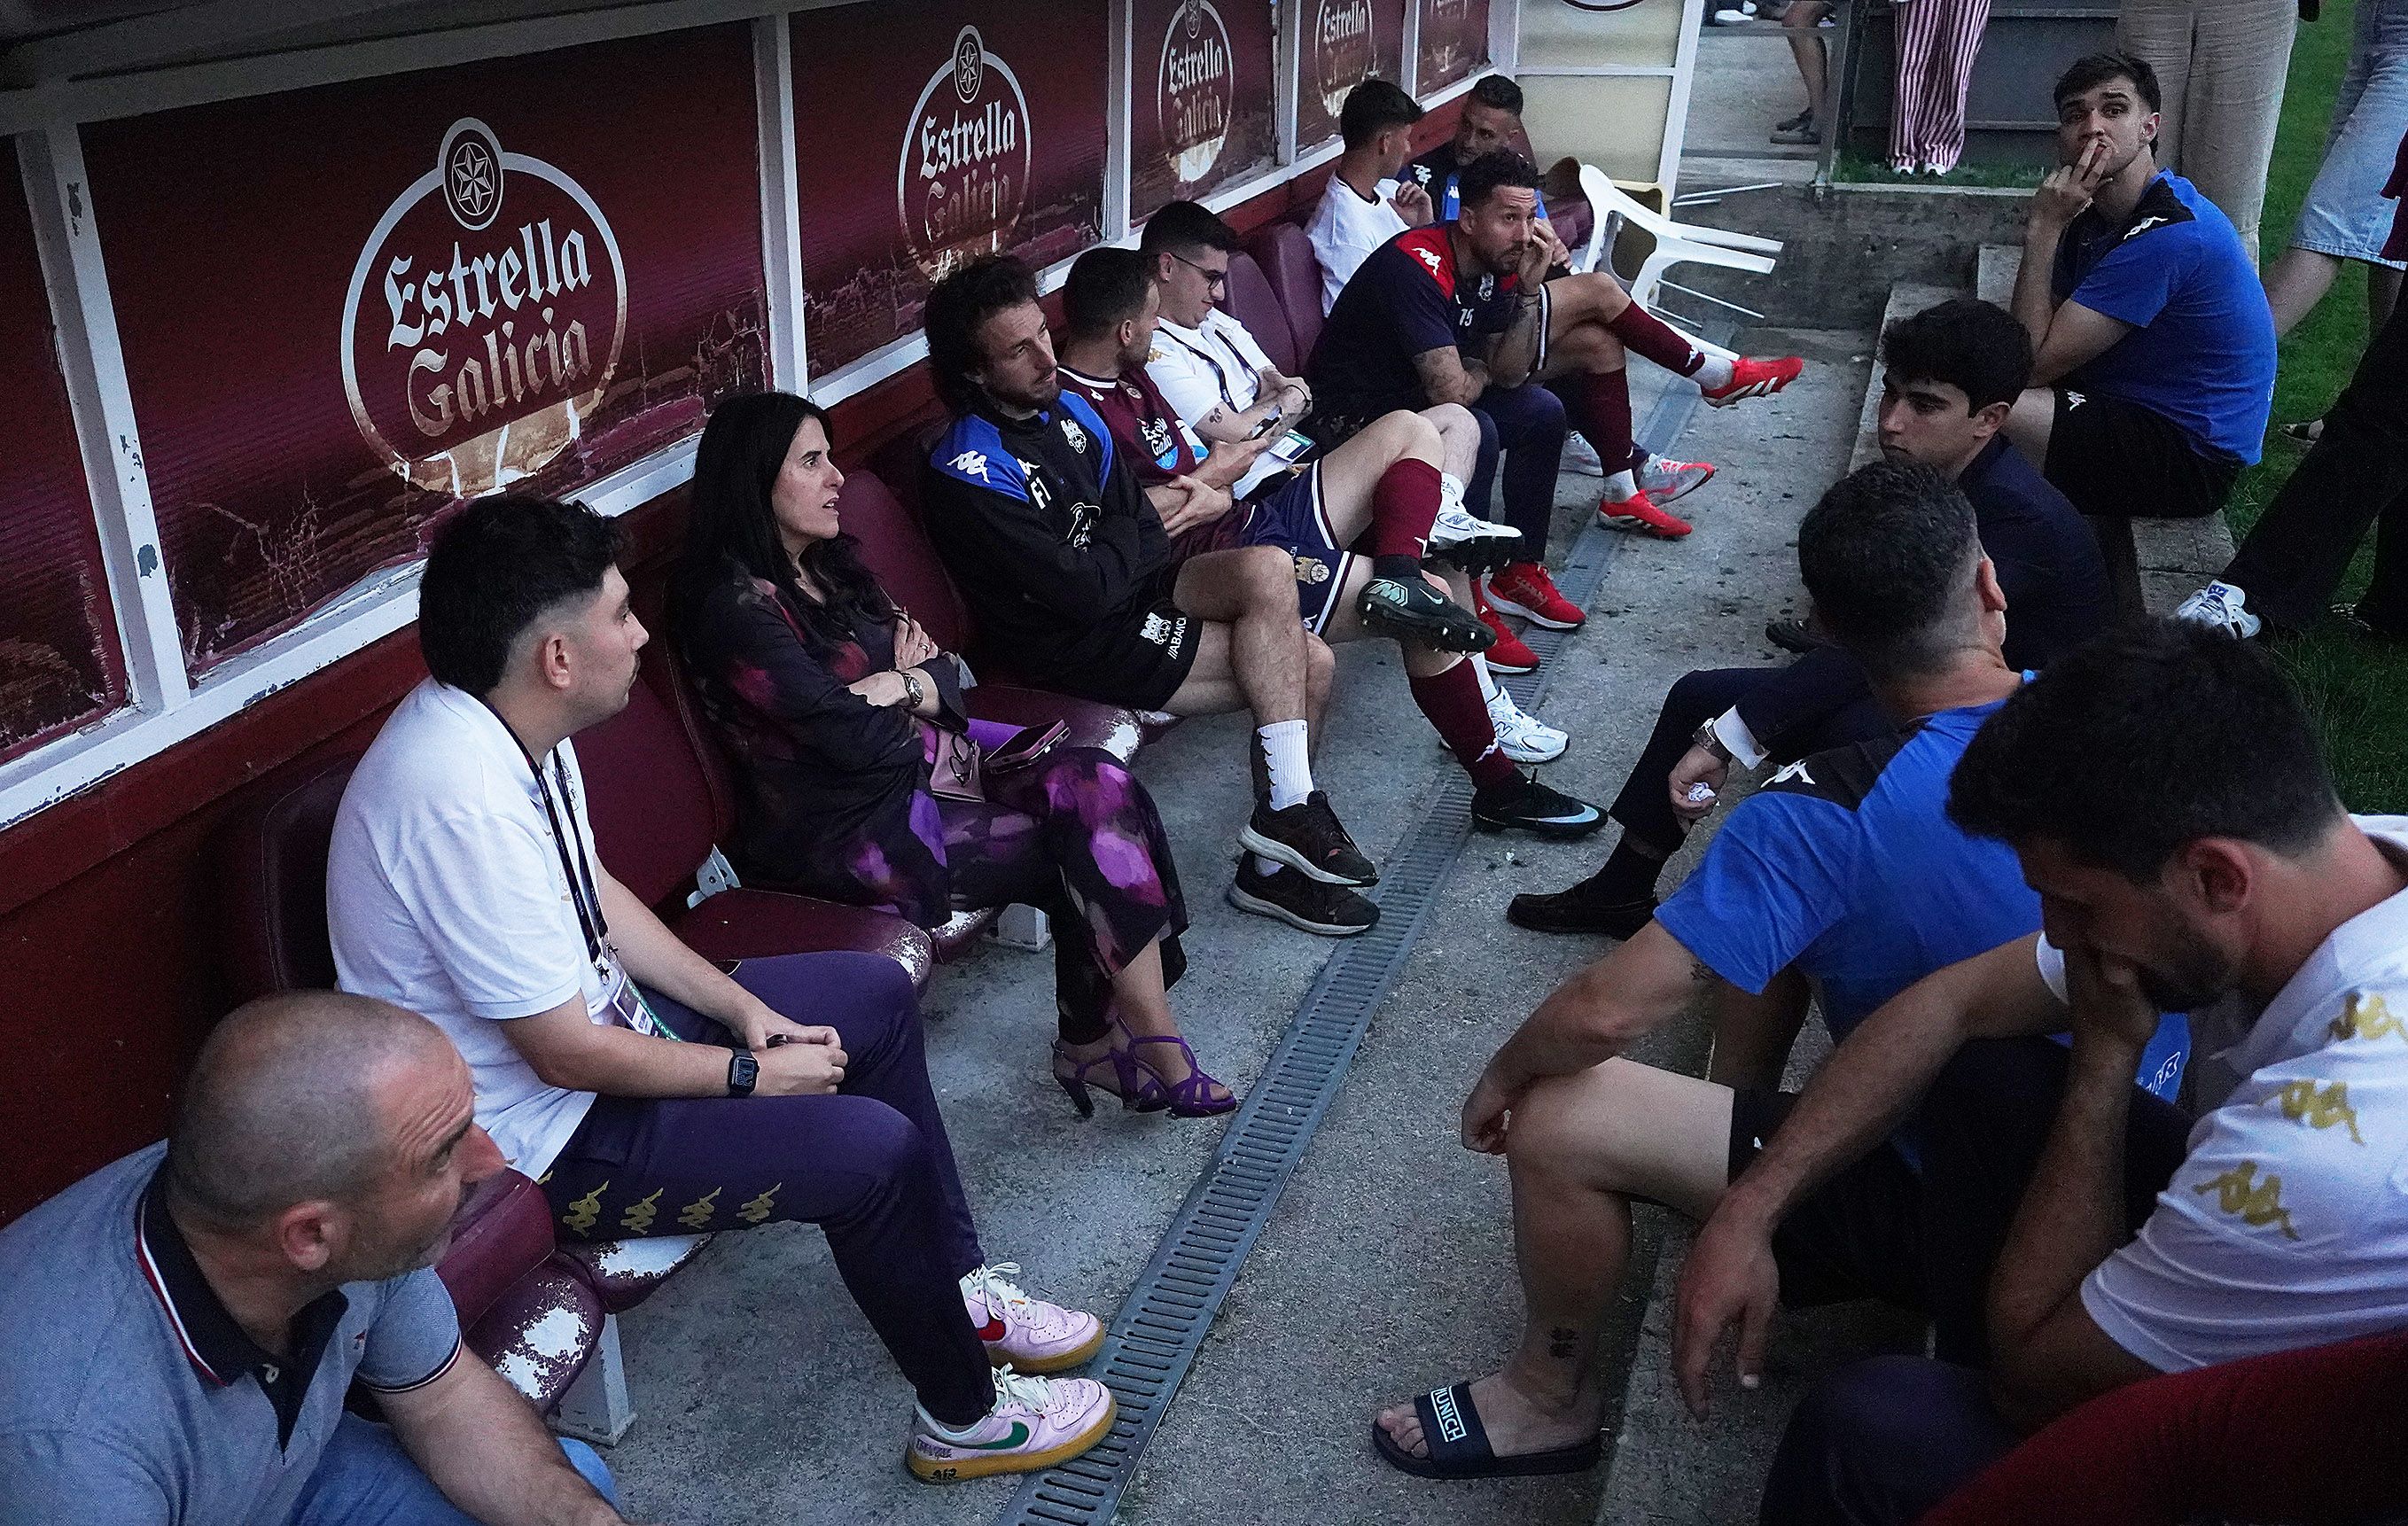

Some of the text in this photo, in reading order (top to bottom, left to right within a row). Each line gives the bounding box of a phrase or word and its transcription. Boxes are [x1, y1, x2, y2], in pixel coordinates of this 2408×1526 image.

[1169, 37, 1224, 95] Estrella
[919, 99, 1017, 181] Estrella
[924, 162, 1010, 241] Galicia
[385, 218, 592, 352] Estrella
[407, 307, 592, 437] Galicia
